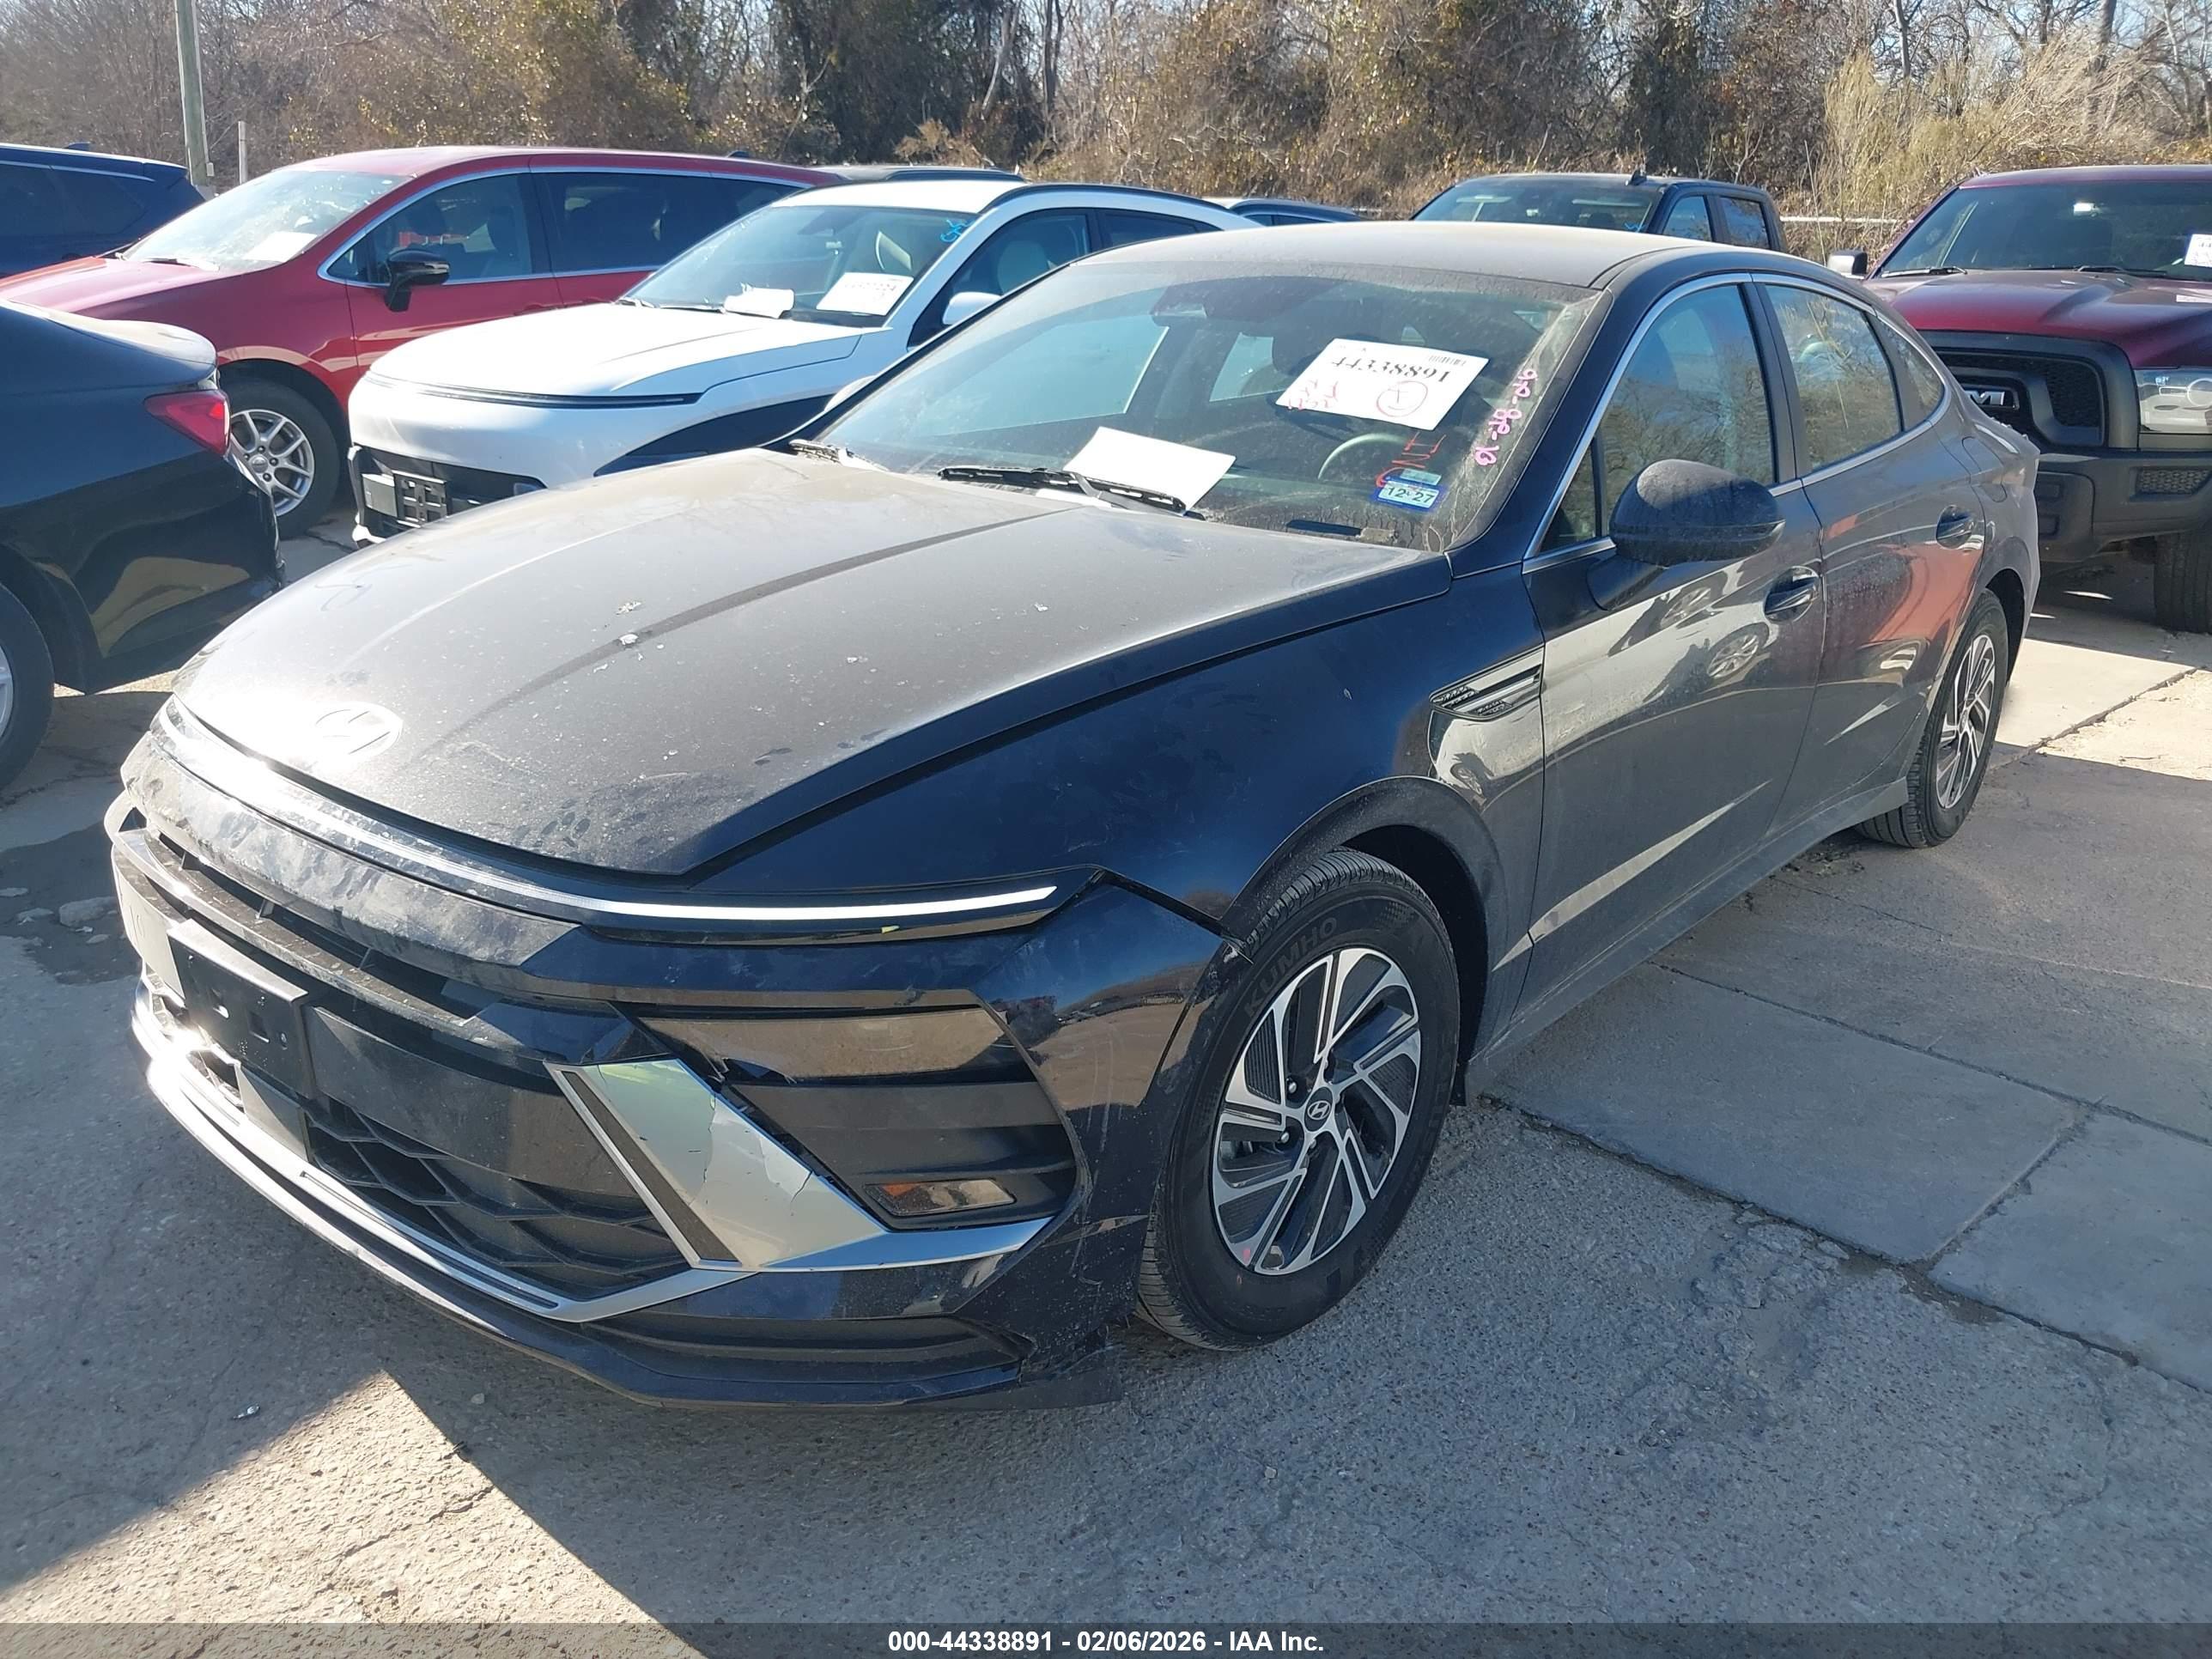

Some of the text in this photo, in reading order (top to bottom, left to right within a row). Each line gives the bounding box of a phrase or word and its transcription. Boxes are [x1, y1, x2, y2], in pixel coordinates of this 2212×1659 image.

[1331, 356, 1450, 383] 44338891
[1386, 486, 1407, 498] 12
[1412, 491, 1435, 503] 27
[1243, 916, 1338, 1018] KUMHO
